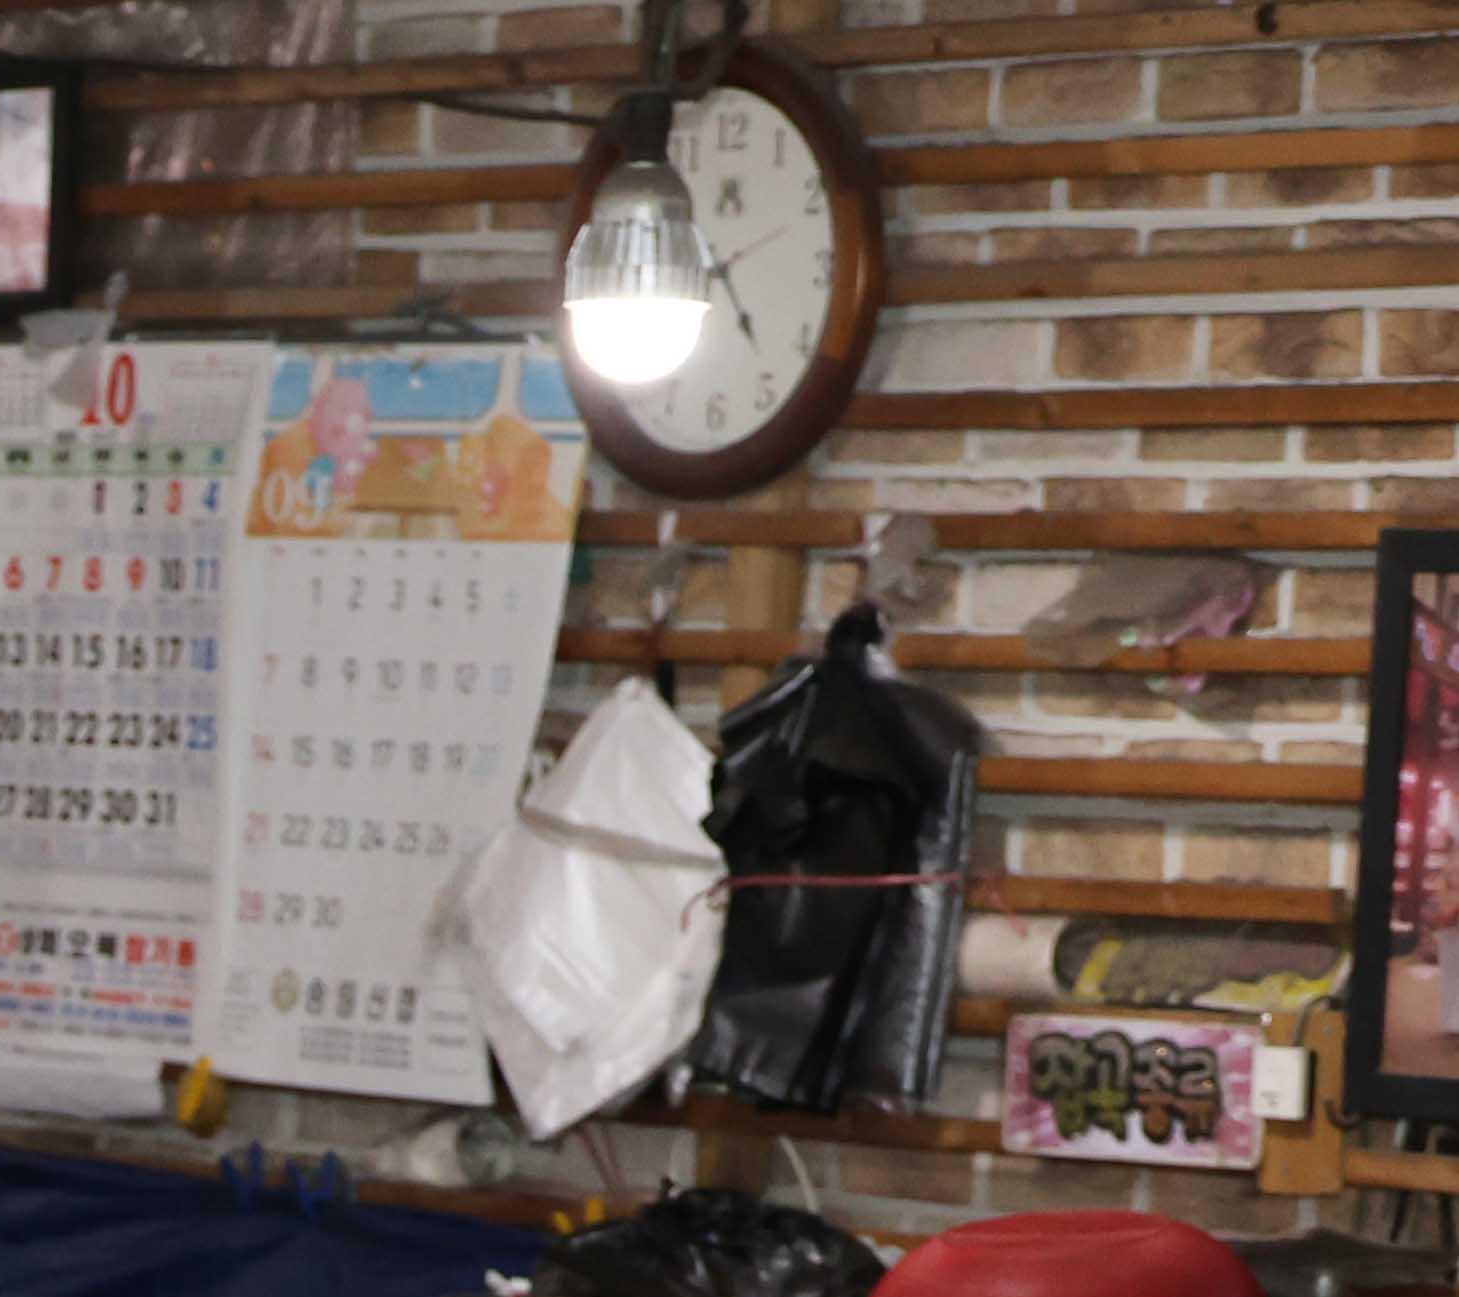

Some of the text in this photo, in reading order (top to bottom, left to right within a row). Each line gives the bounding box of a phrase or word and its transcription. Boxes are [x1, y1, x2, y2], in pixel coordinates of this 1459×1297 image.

[716, 112, 750, 151] 12
[805, 176, 823, 215] 2
[754, 373, 775, 411] 5
[705, 393, 727, 431] 6
[93, 480, 221, 515] 1 2 3 4
[262, 468, 333, 530] 09
[3, 555, 24, 590] 6
[46, 556, 63, 590] 7
[83, 556, 104, 591] 8
[127, 556, 147, 590] 9
[160, 557, 185, 592] 10
[194, 557, 221, 591] 11
[36, 633, 61, 667] 14
[72, 633, 104, 669] 15
[118, 634, 146, 670] 16
[155, 635, 183, 670] 17
[190, 636, 217, 672] 18
[32, 709, 58, 743] 21
[66, 711, 98, 746] 22
[107, 712, 143, 747] 23
[150, 714, 179, 748] 24
[187, 715, 217, 750] 25
[25, 784, 53, 820] 28
[59, 787, 92, 822] 29
[101, 788, 138, 824] 30
[145, 790, 178, 827] 31
